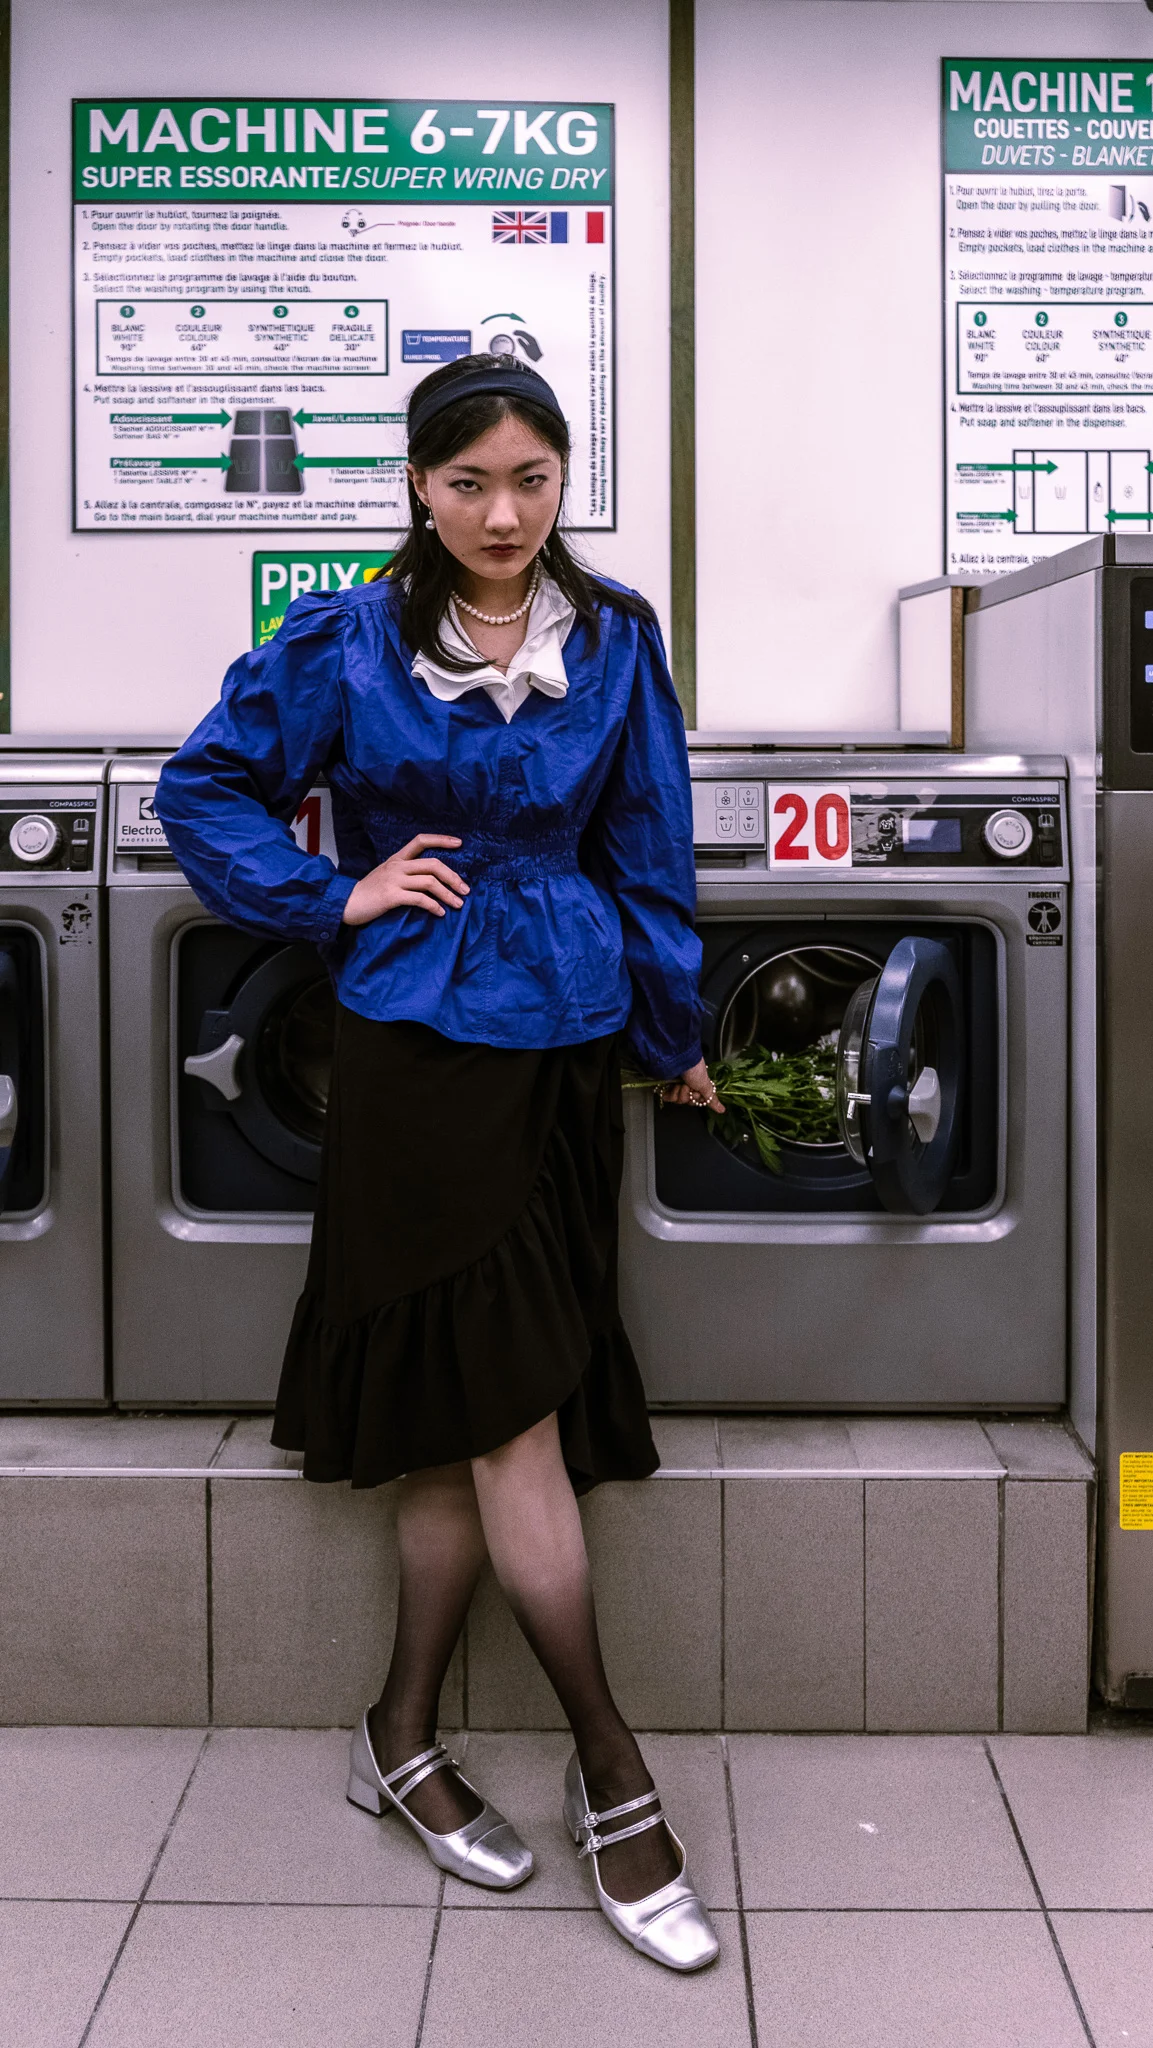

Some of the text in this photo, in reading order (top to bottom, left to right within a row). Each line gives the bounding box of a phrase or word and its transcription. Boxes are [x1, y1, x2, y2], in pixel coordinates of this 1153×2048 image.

[950, 71, 1134, 113] MACHINE
[89, 108, 598, 155] MACHINE 6-7KG
[974, 118, 1070, 139] COUETTES
[1087, 119, 1153, 140] COUVE
[982, 145, 1055, 166] DUVETS
[82, 166, 607, 189] SUPER ESSORANTE/SUPER WRING DRY
[91, 222, 117, 231] Open
[118, 222, 134, 230] the
[136, 222, 158, 230] door
[160, 223, 171, 231] by
[173, 222, 211, 232] rotating
[212, 222, 229, 230] the
[230, 222, 252, 230] door
[92, 253, 123, 262] Empty
[190, 254, 226, 262] clothes
[238, 254, 255, 262] the
[256, 254, 298, 262] machine
[299, 254, 317, 262] and
[319, 254, 345, 262] close
[347, 254, 363, 262] the
[111, 324, 145, 332] BLANC
[175, 324, 222, 332] COULEUR
[248, 324, 315, 333] SYNTHETIQUE
[332, 324, 372, 332] FRAGILE
[967, 330, 996, 339] BLANC
[1022, 330, 1063, 339] COULEUR
[1093, 330, 1150, 340] SYNTHETIQUE
[968, 342, 994, 350] WHITE
[1025, 342, 1060, 351] COLOUR
[1099, 342, 1145, 351] SYNTHETIC
[93, 395, 110, 404] Put
[112, 397, 135, 405] soap
[137, 396, 155, 404] and
[157, 396, 197, 404] softener
[210, 396, 226, 404] the
[112, 415, 173, 423] Adoucissant
[960, 416, 975, 427] Put
[977, 419, 998, 428] soap
[999, 418, 1016, 427] and
[1017, 417, 1054, 427] softener
[1056, 419, 1064, 427] in
[1066, 418, 1080, 427] the
[94, 512, 107, 521] Go
[121, 513, 137, 521] the
[196, 513, 214, 521] dial
[215, 514, 236, 522] your
[238, 513, 280, 521] machine
[281, 513, 318, 521] number
[261, 563, 360, 605] PRIX
[260, 615, 285, 633] LAV
[121, 825, 164, 835] Electro
[774, 793, 849, 860] 20
